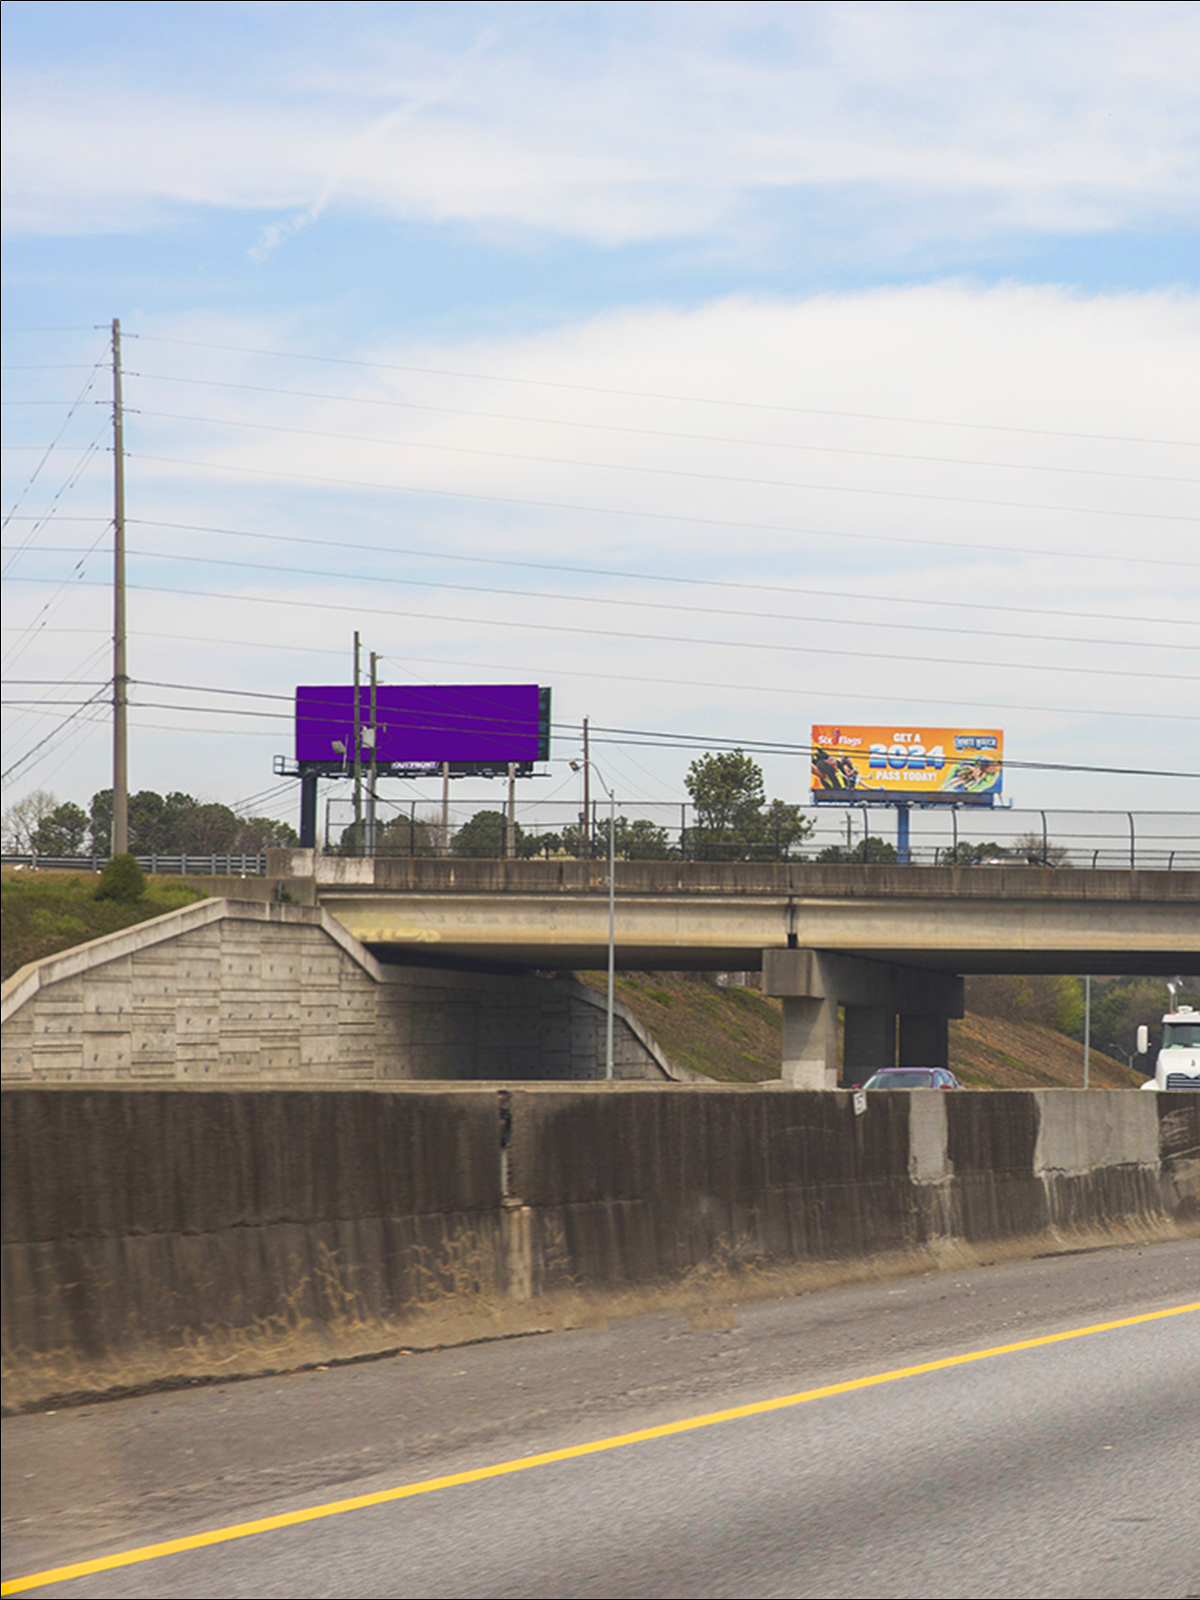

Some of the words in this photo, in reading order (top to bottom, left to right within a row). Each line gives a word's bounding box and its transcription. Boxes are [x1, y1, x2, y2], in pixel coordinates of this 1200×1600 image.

[818, 735, 833, 745] Six
[838, 735, 862, 747] Flags
[893, 733, 912, 743] GET
[914, 734, 921, 743] A
[869, 744, 945, 770] 2024
[875, 771, 900, 782] PASS
[902, 772, 938, 782] TODAY!
